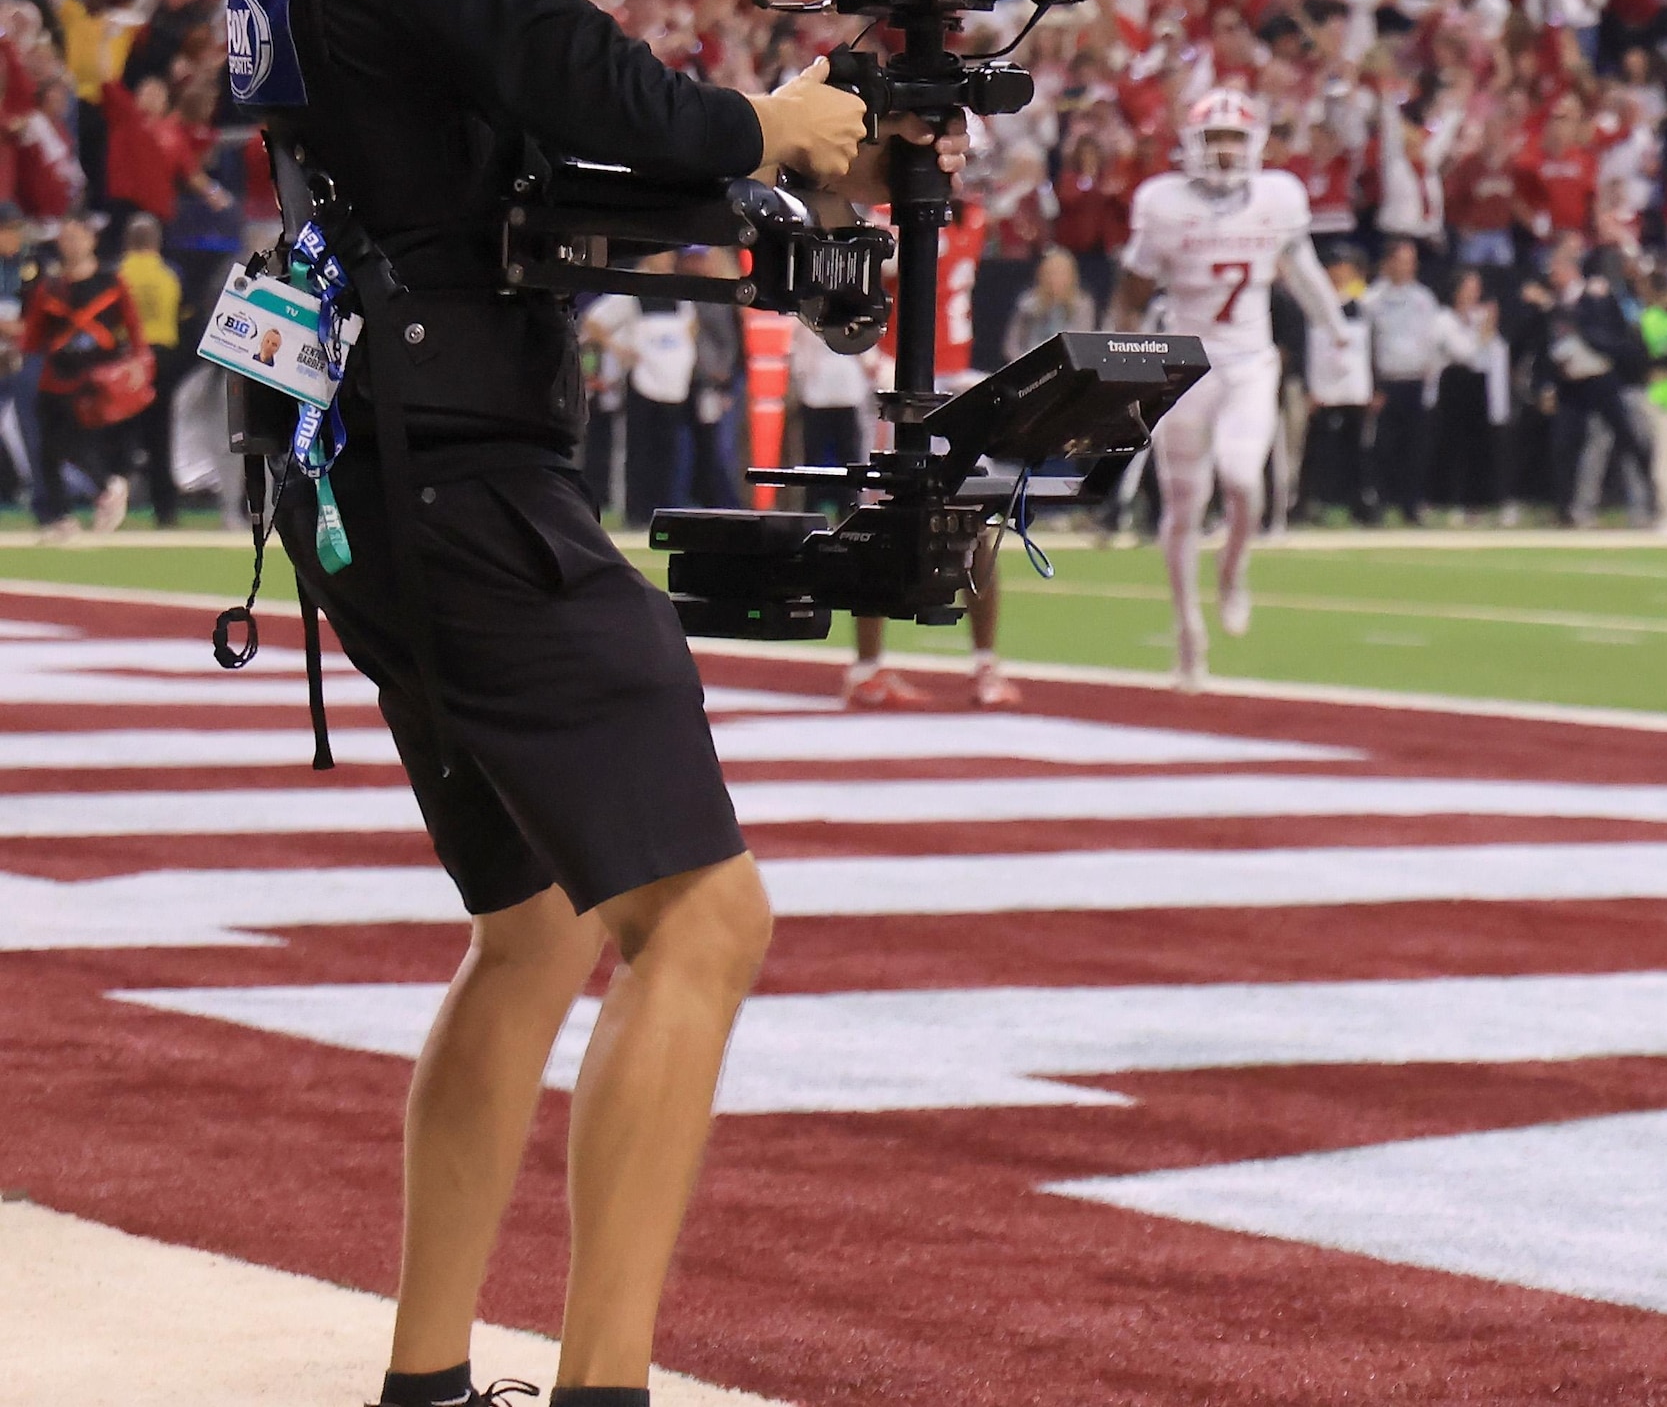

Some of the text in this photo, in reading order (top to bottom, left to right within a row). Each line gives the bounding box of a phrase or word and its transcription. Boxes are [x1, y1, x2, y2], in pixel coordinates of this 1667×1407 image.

[227, 8, 252, 56] FOX
[228, 56, 254, 76] SPORTS
[1211, 261, 1251, 323] 7
